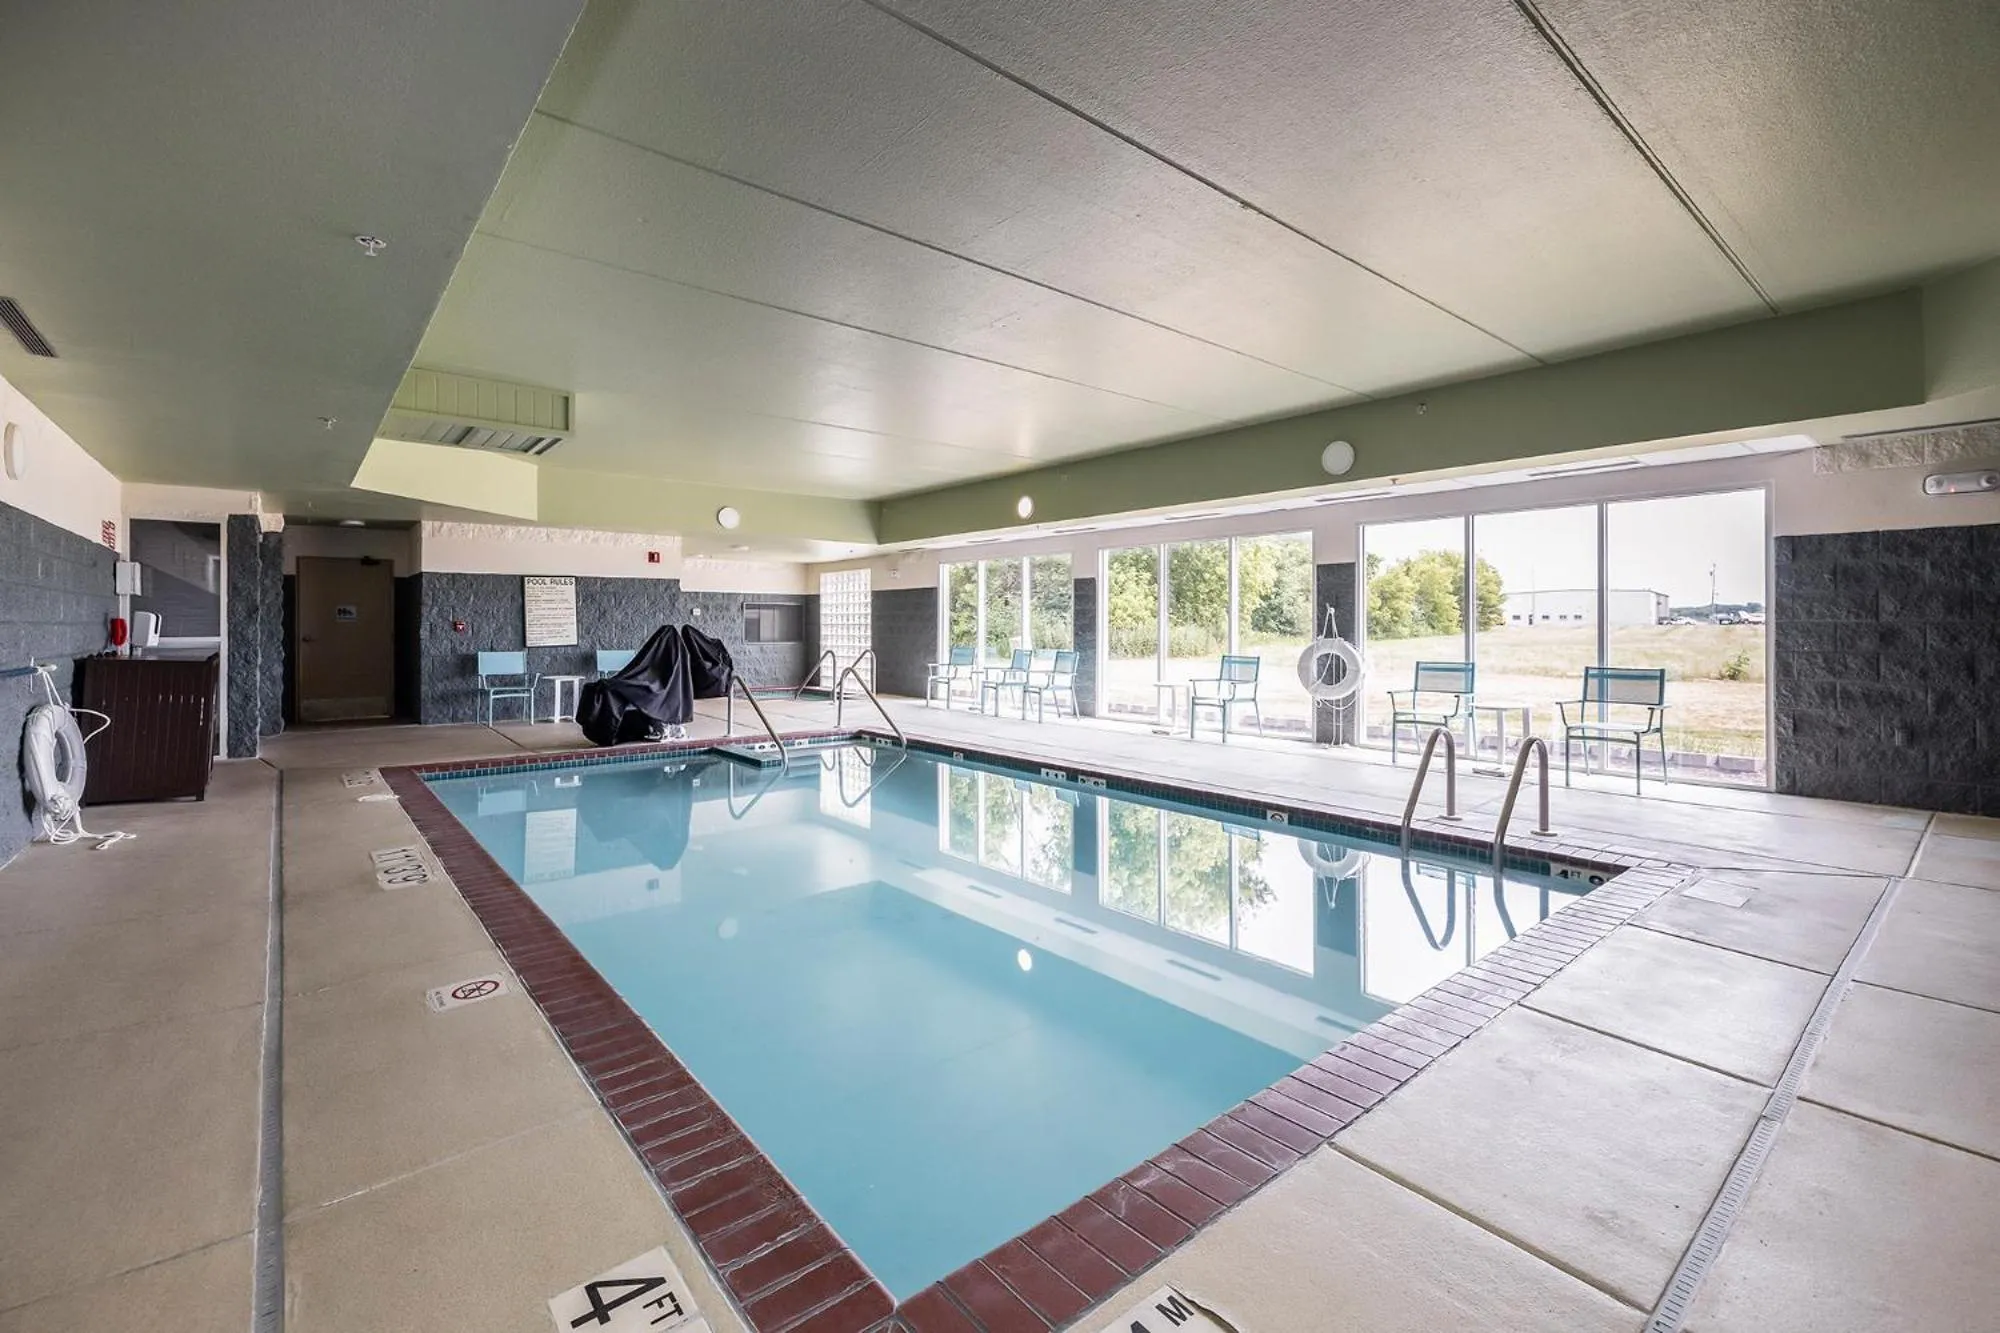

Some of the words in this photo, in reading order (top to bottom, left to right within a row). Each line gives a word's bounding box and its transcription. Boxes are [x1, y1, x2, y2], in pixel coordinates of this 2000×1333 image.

[526, 577, 547, 586] POOL
[550, 577, 574, 586] RULES
[570, 1277, 667, 1329] 4
[642, 1291, 684, 1325] FT
